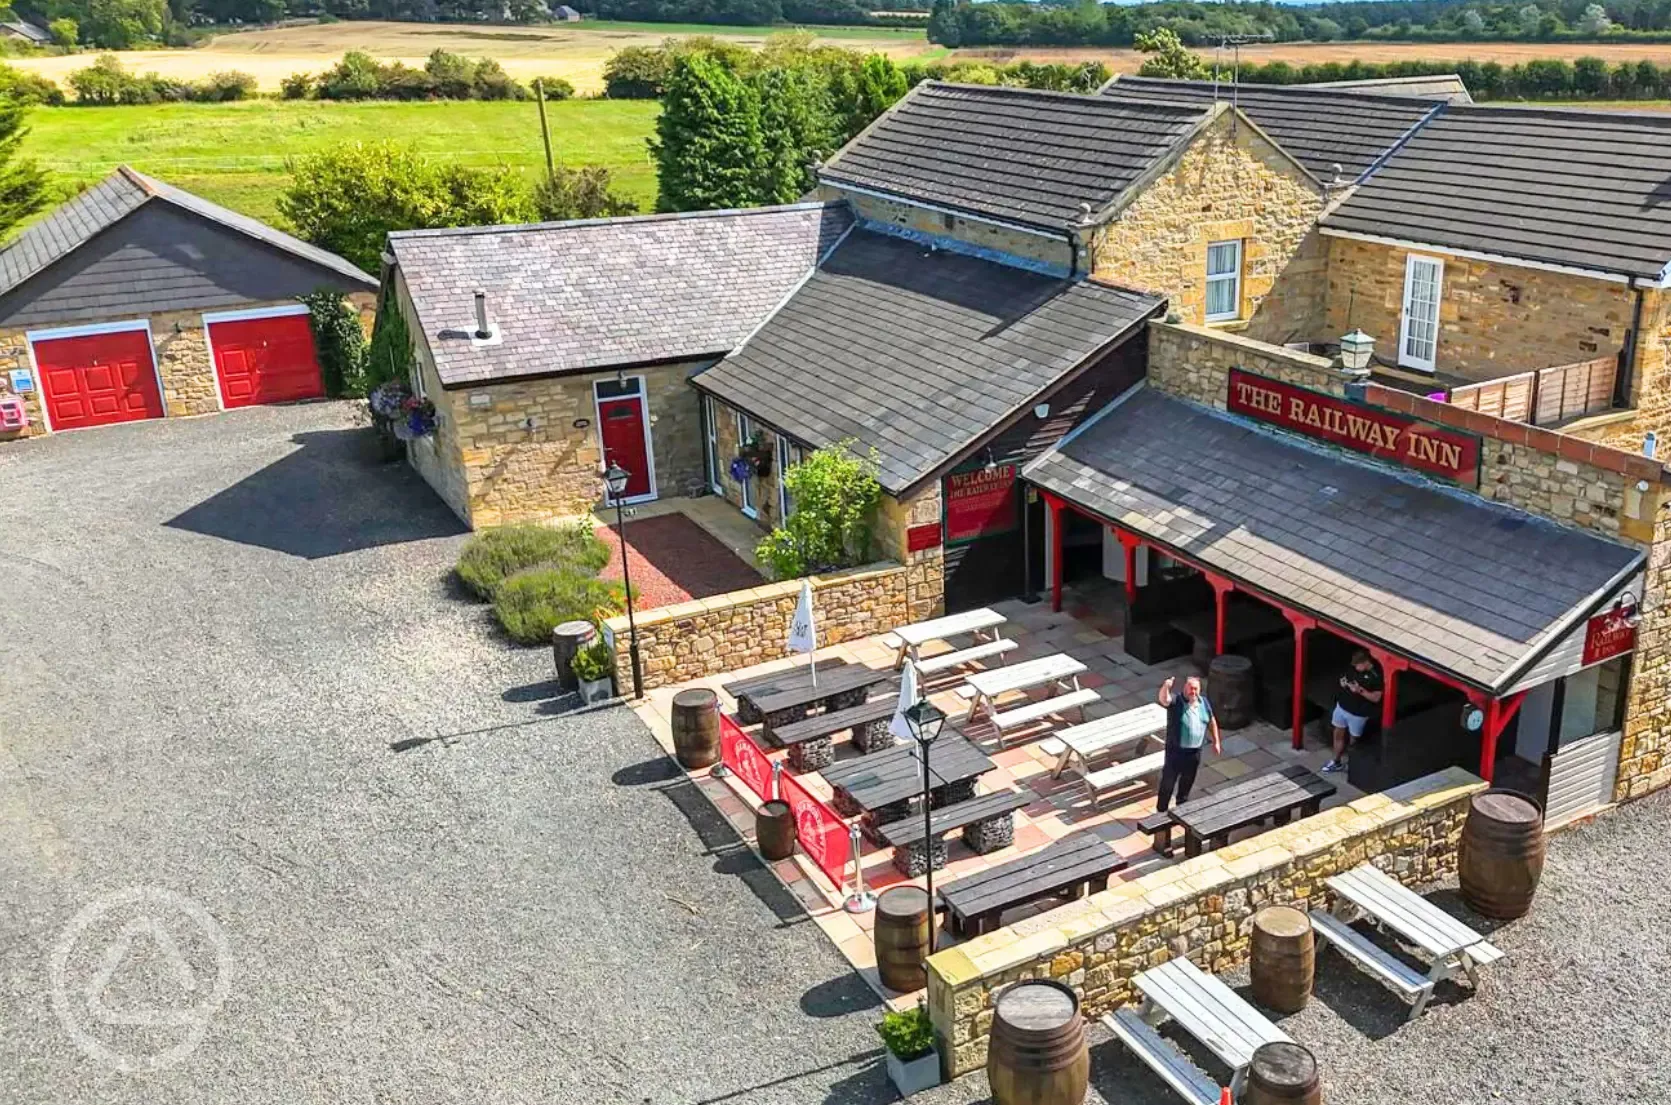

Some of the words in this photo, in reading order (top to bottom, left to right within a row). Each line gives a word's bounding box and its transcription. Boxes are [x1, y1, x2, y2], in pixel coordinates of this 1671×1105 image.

[1237, 381, 1282, 415] THE
[1289, 396, 1399, 450] RAILWAY
[1407, 432, 1462, 470] INN
[951, 465, 1011, 487] WELCOME
